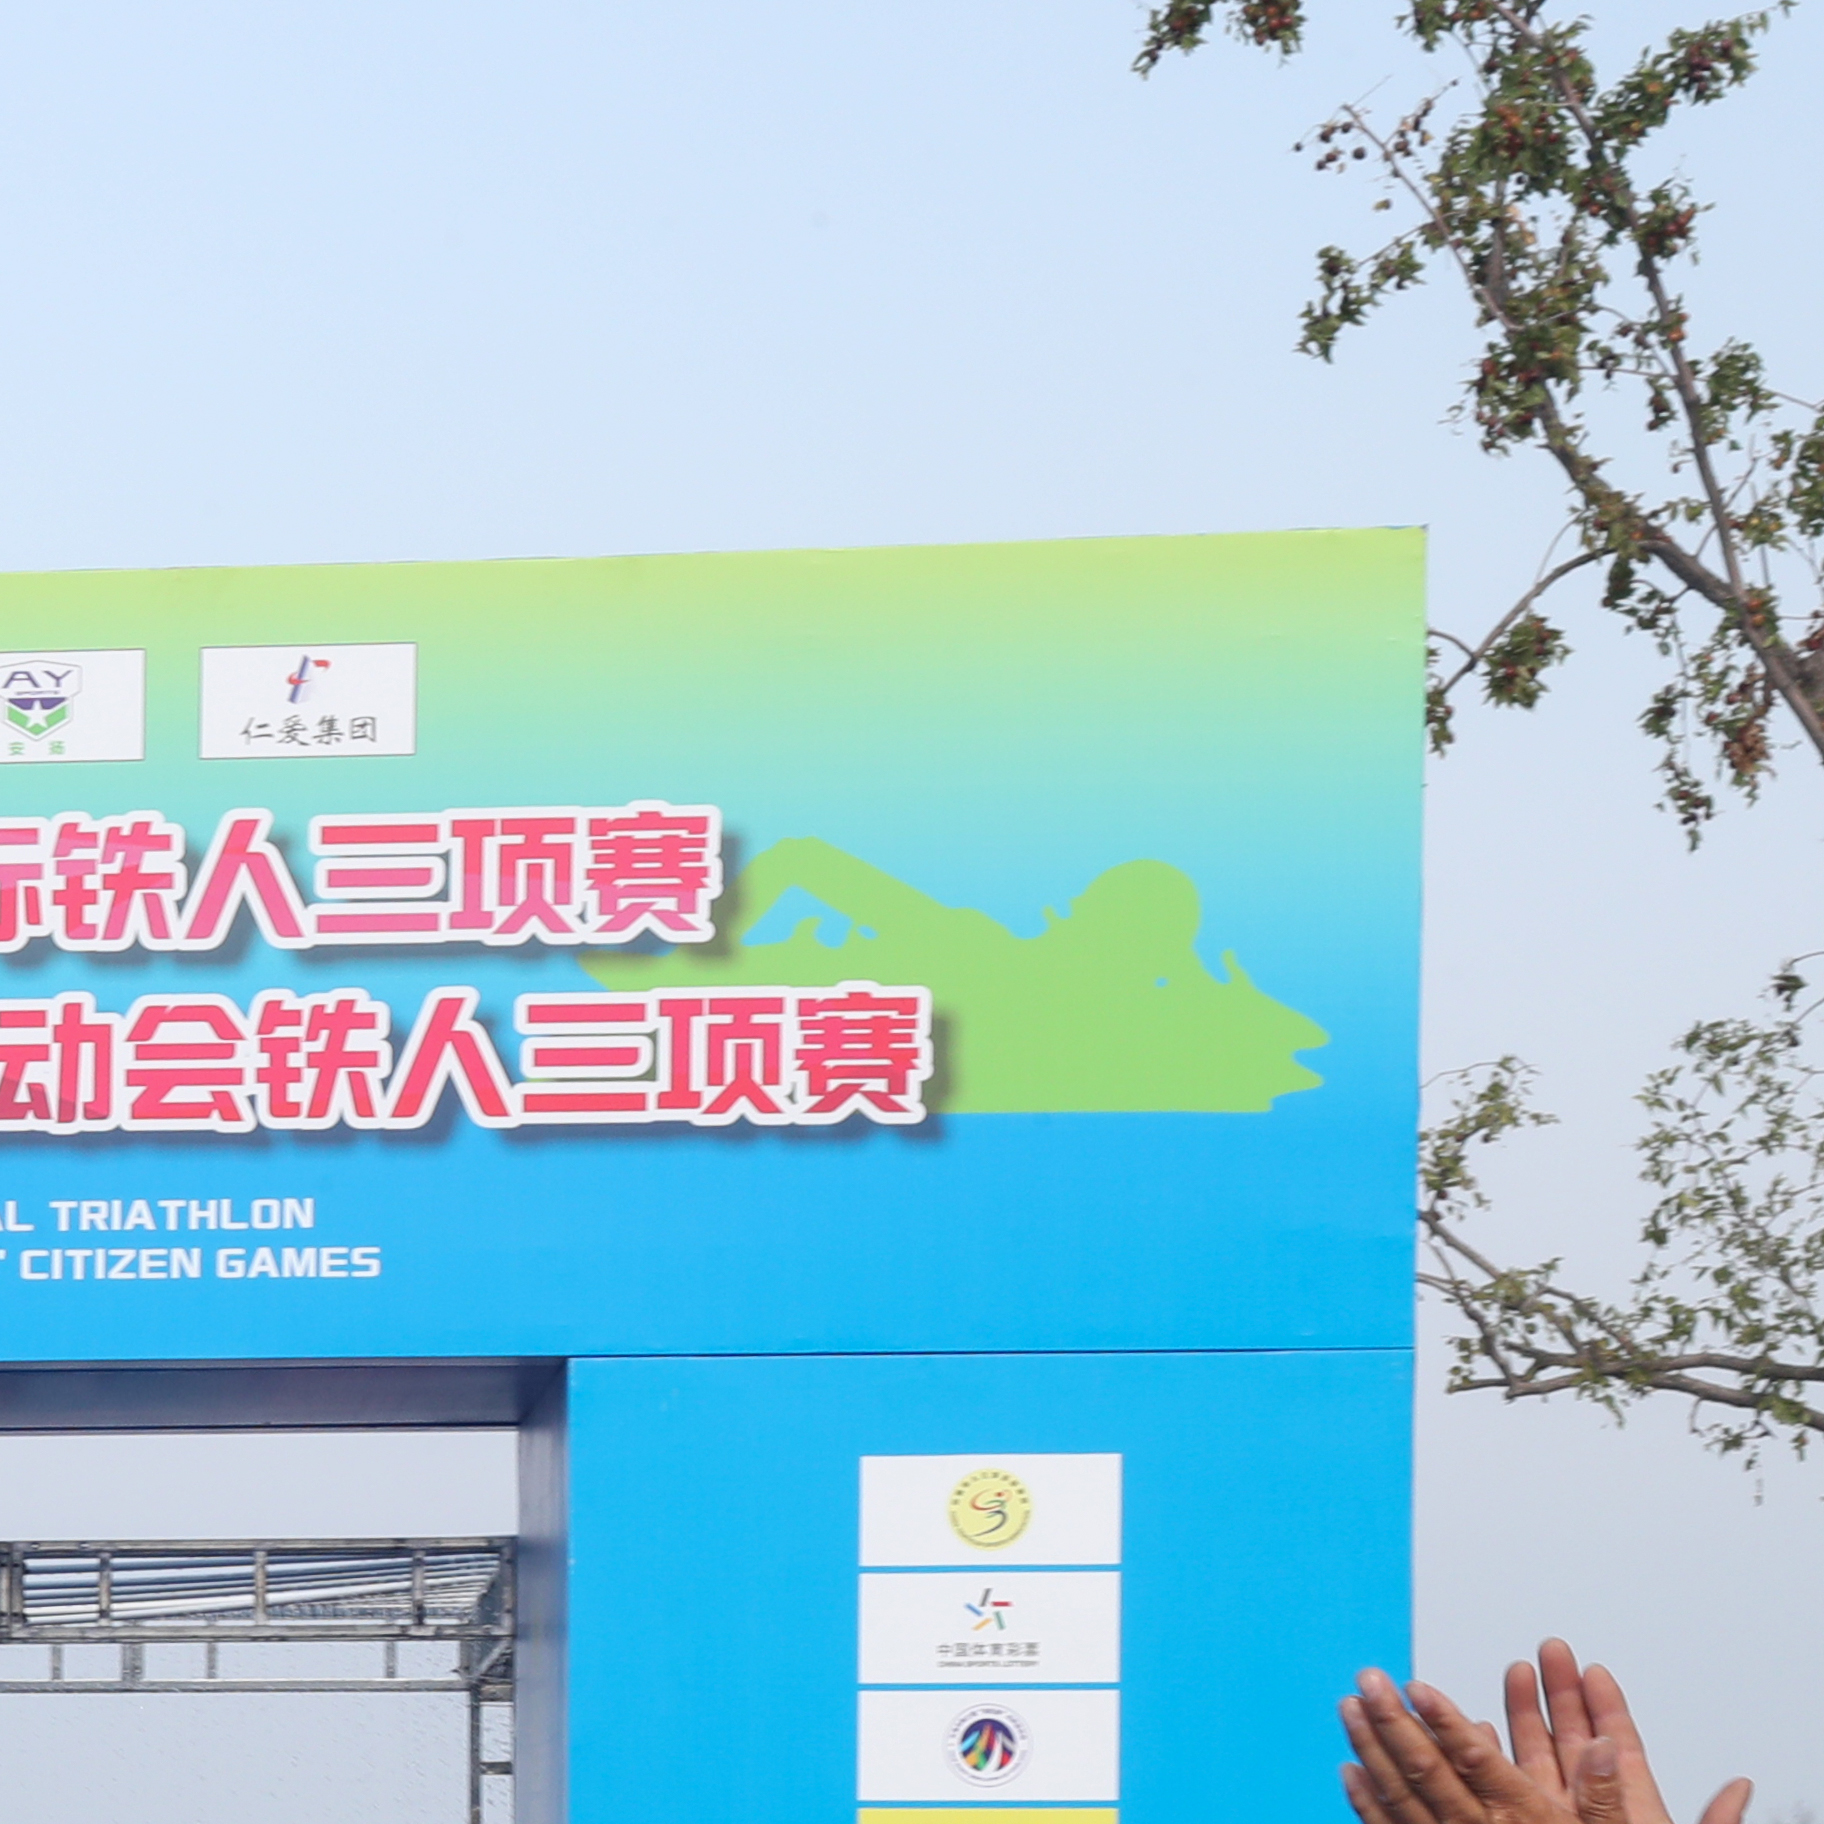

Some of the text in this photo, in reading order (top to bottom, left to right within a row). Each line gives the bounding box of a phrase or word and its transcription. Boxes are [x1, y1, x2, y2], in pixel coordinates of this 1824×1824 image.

[2, 669, 74, 690] AY
[238, 715, 378, 748] 仁爱集团
[49, 1198, 316, 1233] TRIATHLON
[19, 1248, 202, 1281] CITIZEN
[215, 1246, 383, 1279] GAMES
